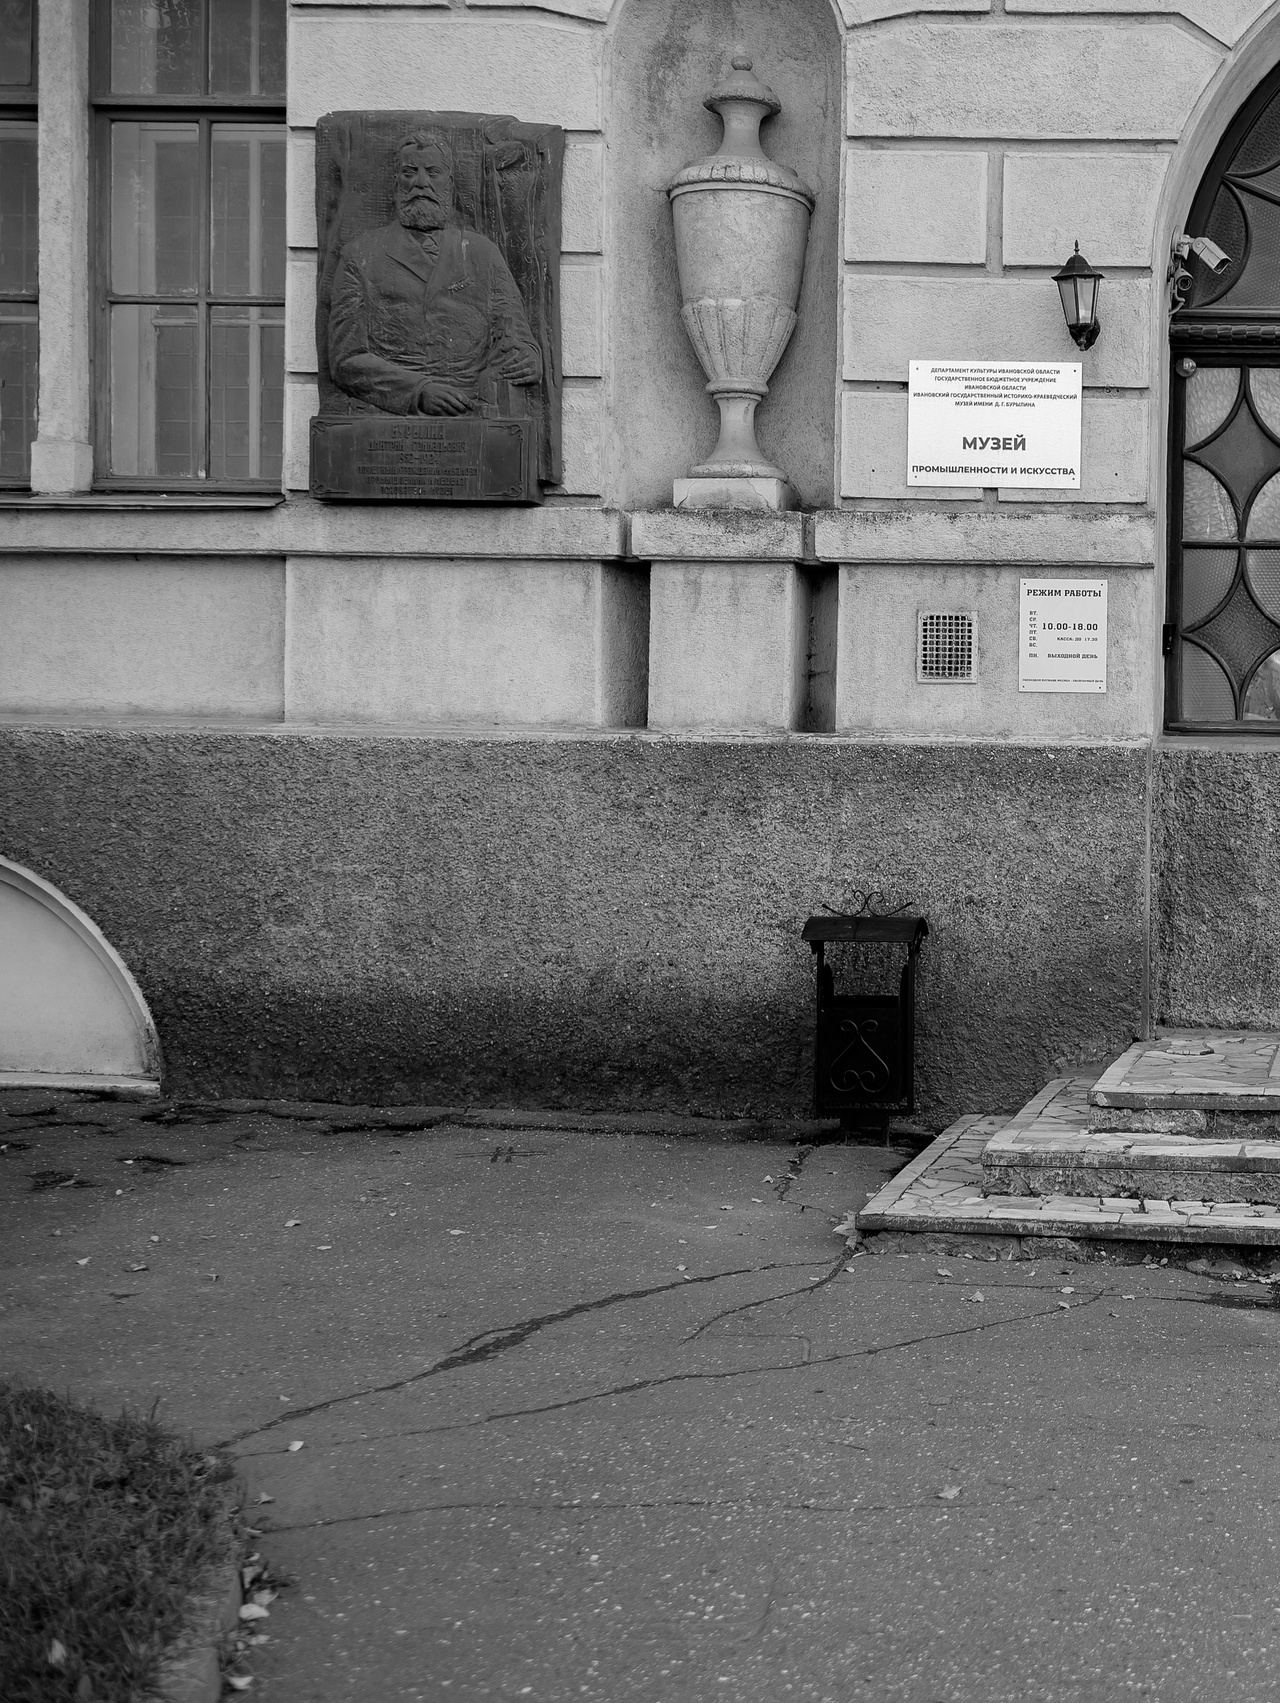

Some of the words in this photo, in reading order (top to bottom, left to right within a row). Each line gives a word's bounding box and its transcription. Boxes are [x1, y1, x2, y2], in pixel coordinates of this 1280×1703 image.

[934, 375, 986, 383] ГОСУДАРСТВЕННОЕ
[994, 401, 1001, 409] Д.
[962, 434, 1026, 451] МУЗЕЙ
[912, 465, 1008, 474] ПРОМЫШЛЕННОСТИ
[1010, 467, 1018, 475] И
[1020, 467, 1076, 475] ИСКУССТВА
[1027, 589, 1061, 597] РЕЖИМ
[1064, 589, 1101, 597] РАБОТЫ
[1042, 622, 1098, 631] 10.00-18.00
